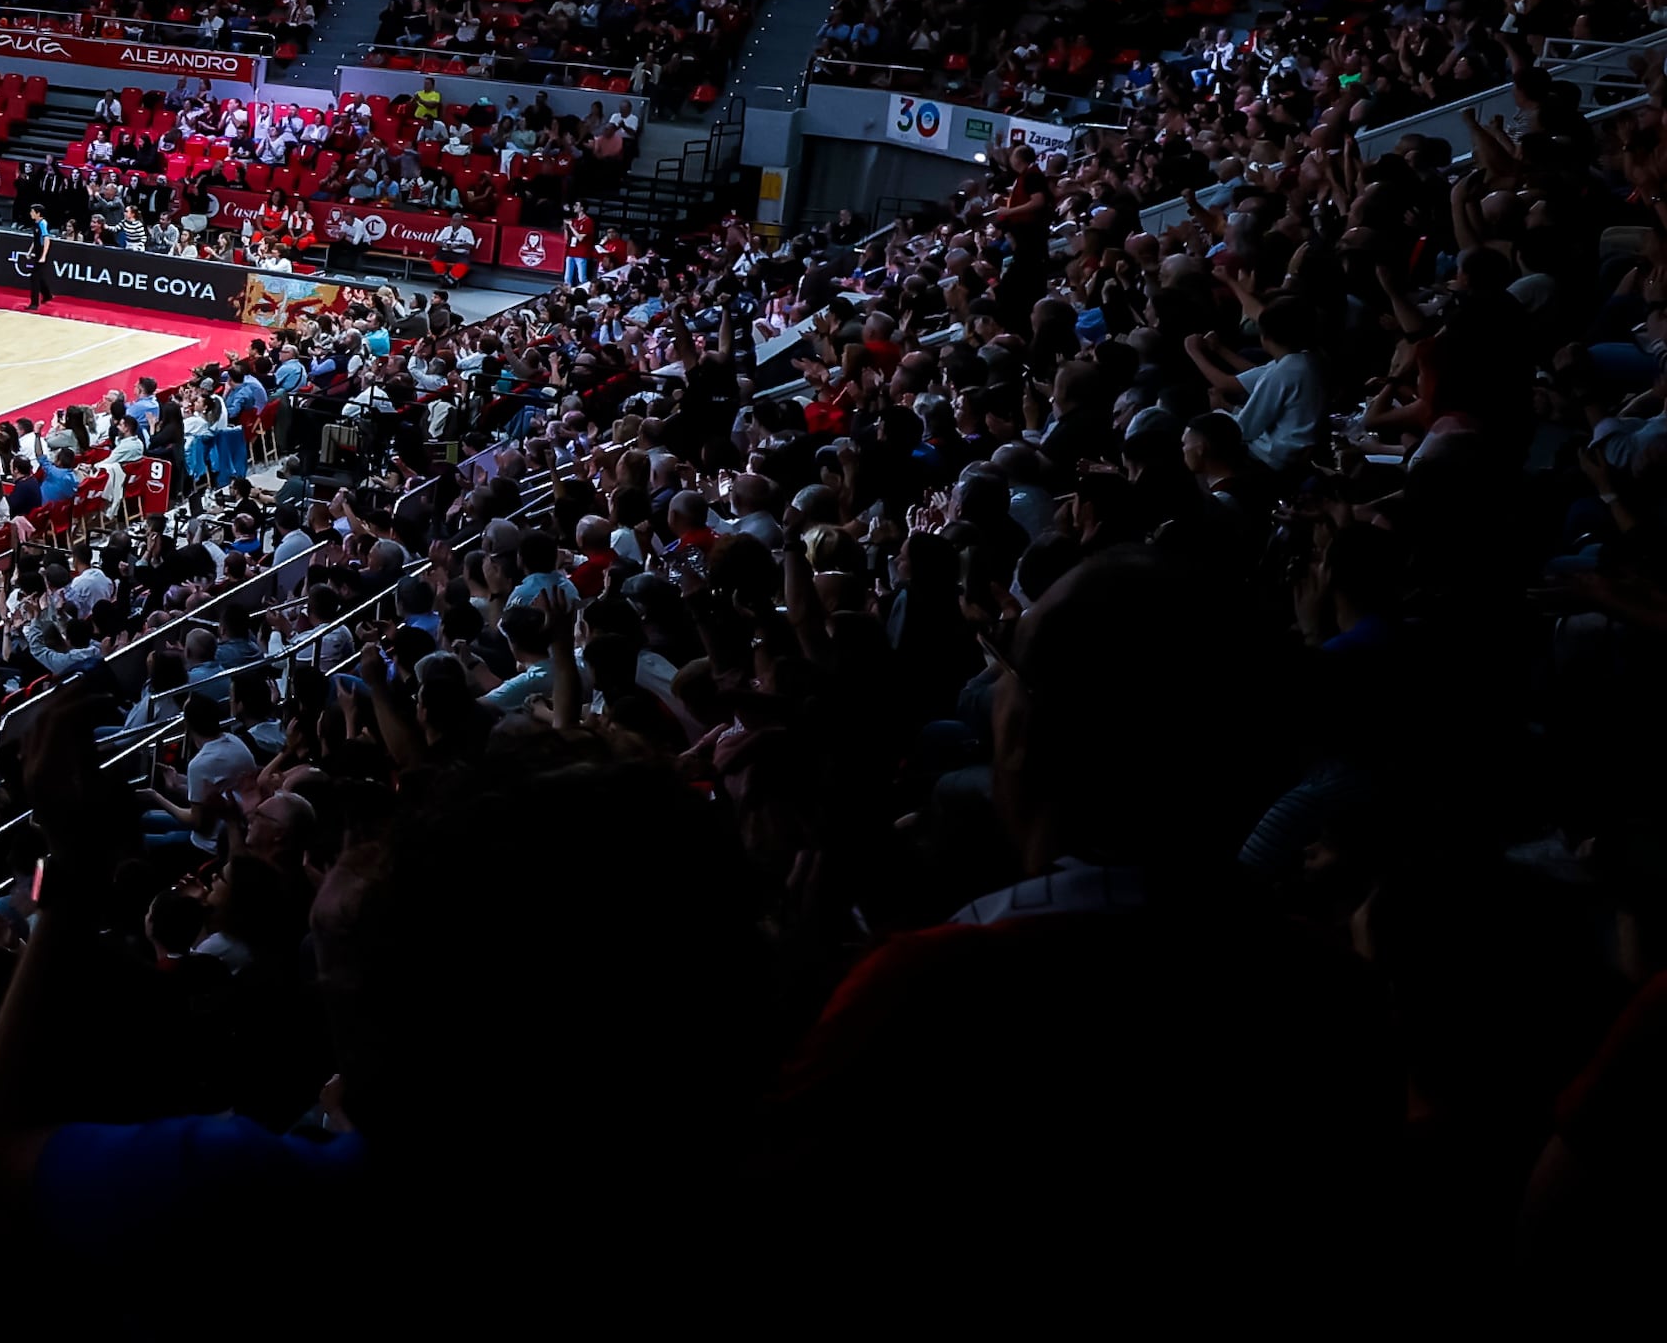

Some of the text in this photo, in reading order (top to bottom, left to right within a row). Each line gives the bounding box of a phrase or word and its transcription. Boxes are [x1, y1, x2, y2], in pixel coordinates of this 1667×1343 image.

[120, 48, 239, 72] ALEJANDRO
[896, 98, 940, 138] 30
[52, 260, 217, 301] VILLA DE GOYA
[150, 461, 164, 480] 9
